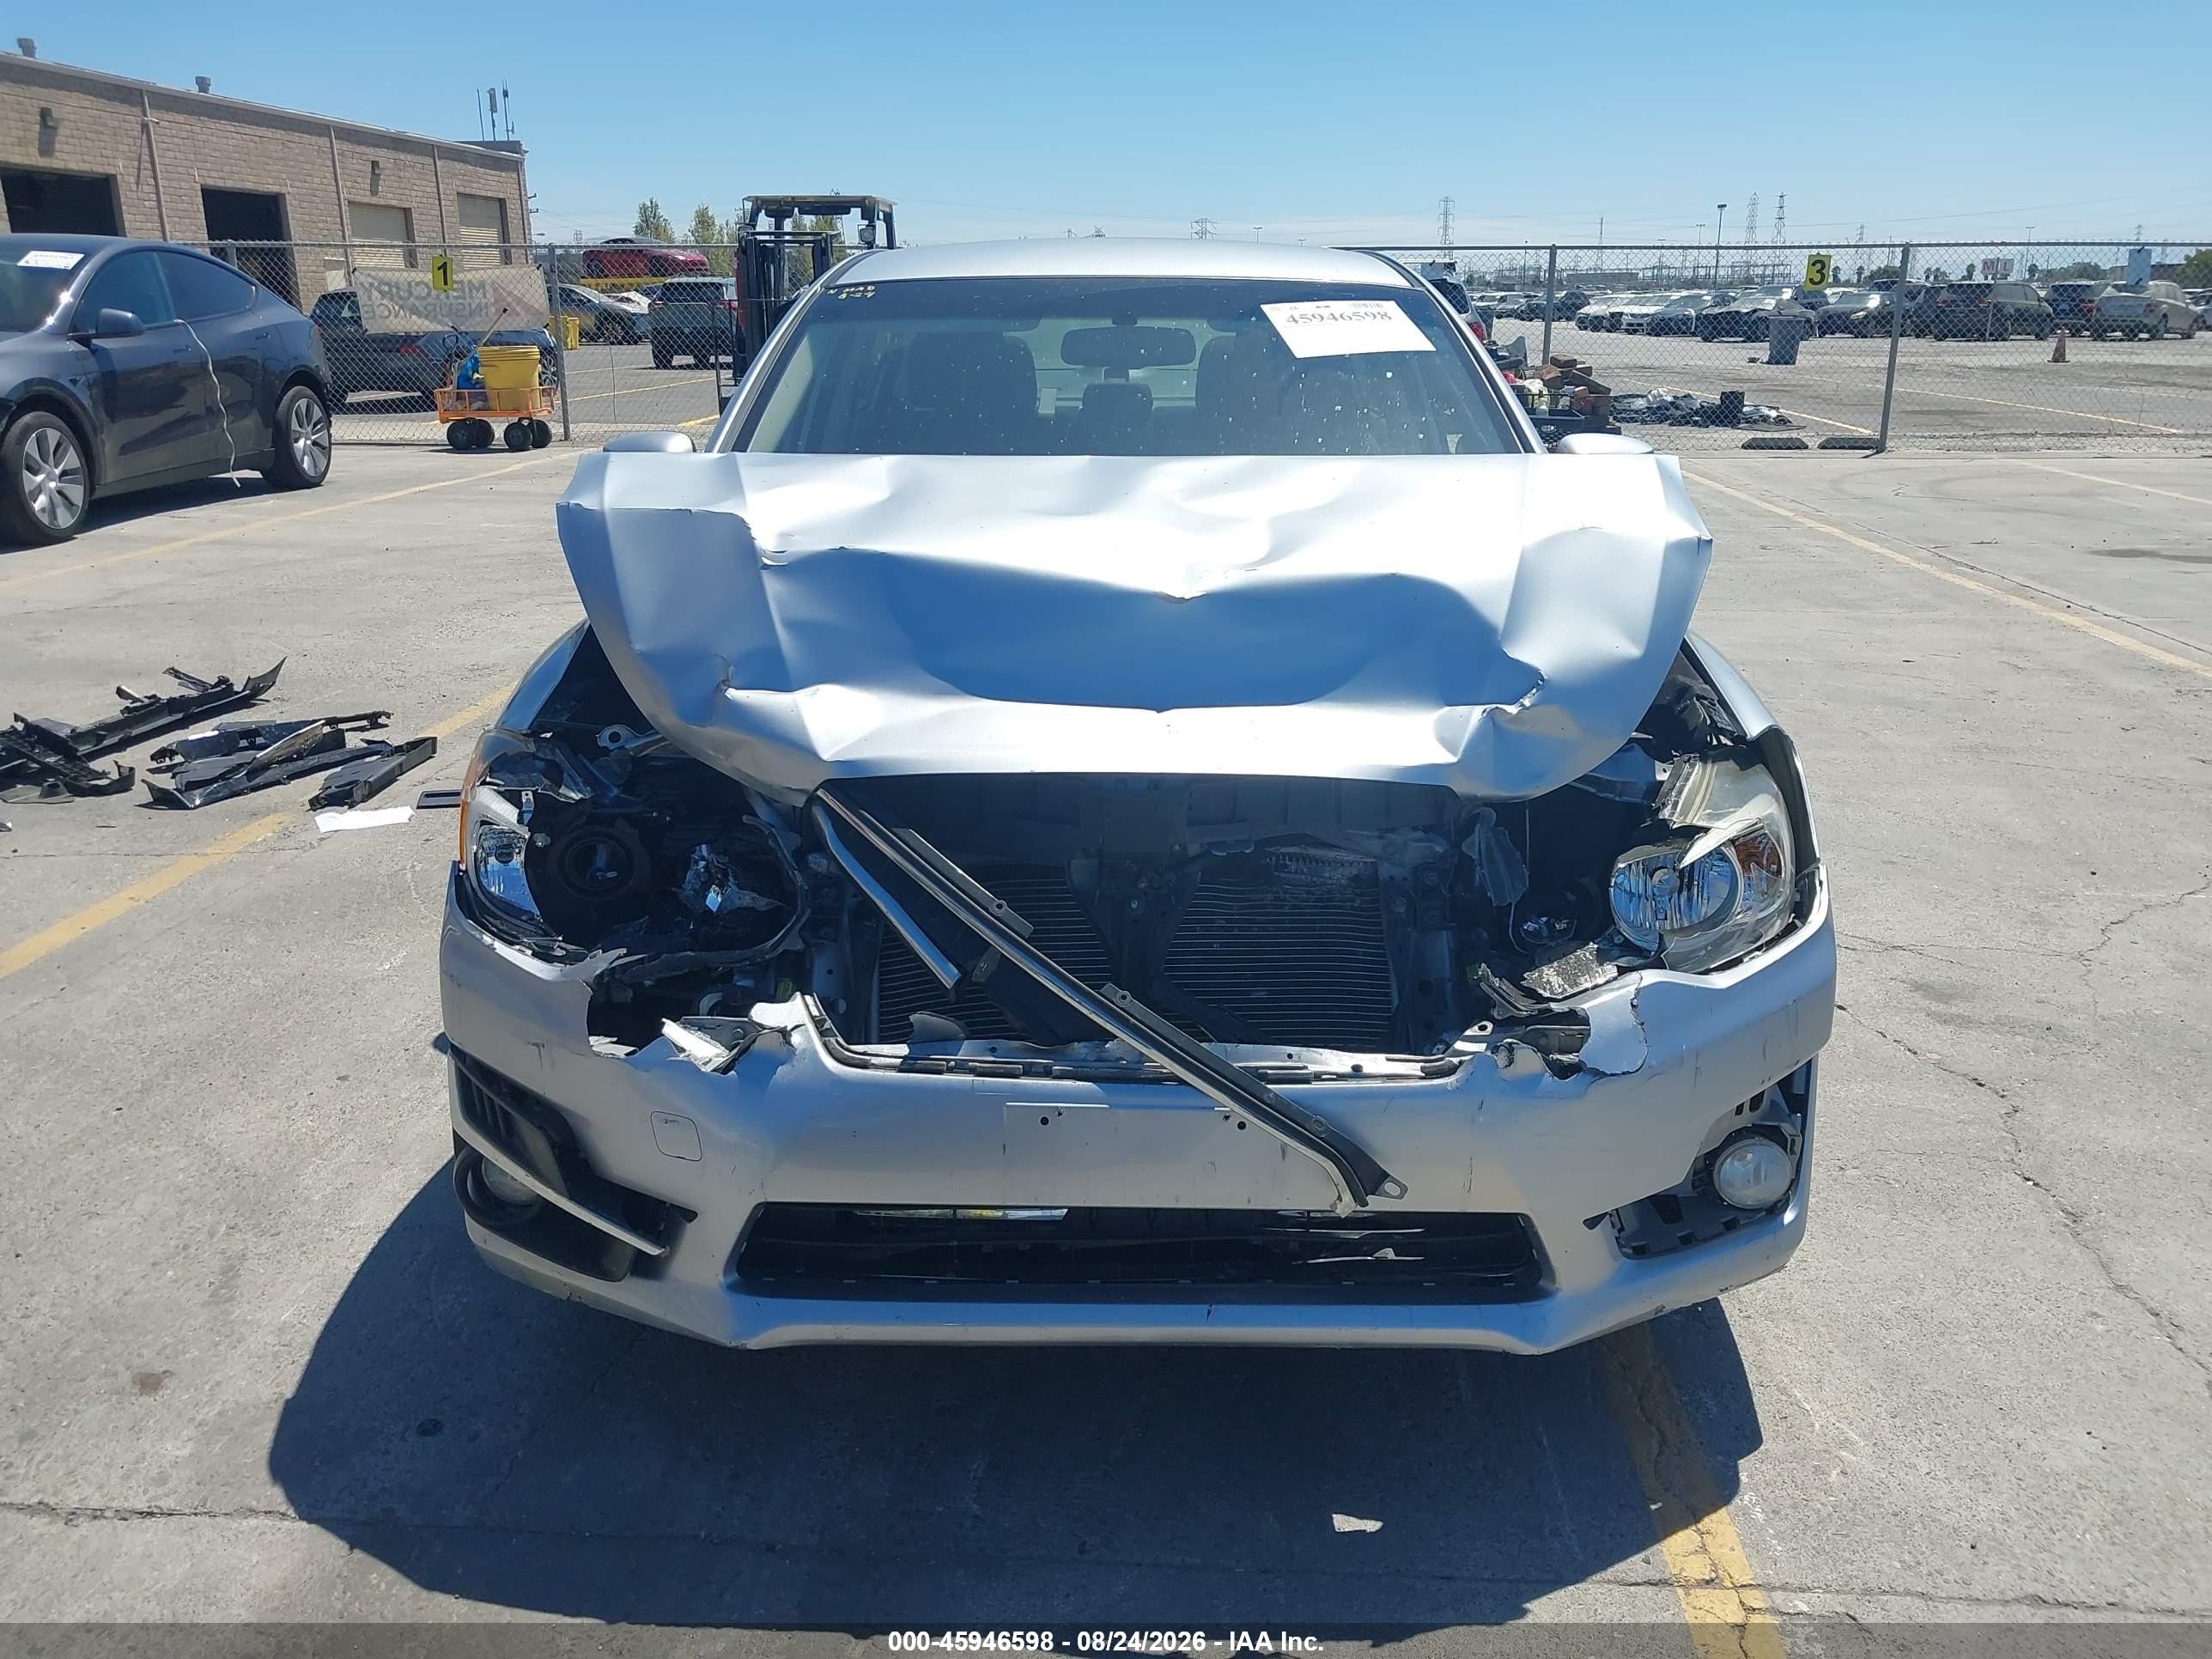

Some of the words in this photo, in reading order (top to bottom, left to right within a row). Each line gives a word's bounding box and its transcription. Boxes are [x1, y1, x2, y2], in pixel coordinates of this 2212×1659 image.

[437, 261, 448, 286] 1
[1808, 259, 1826, 286] 3
[1286, 311, 1393, 325] 45946598
